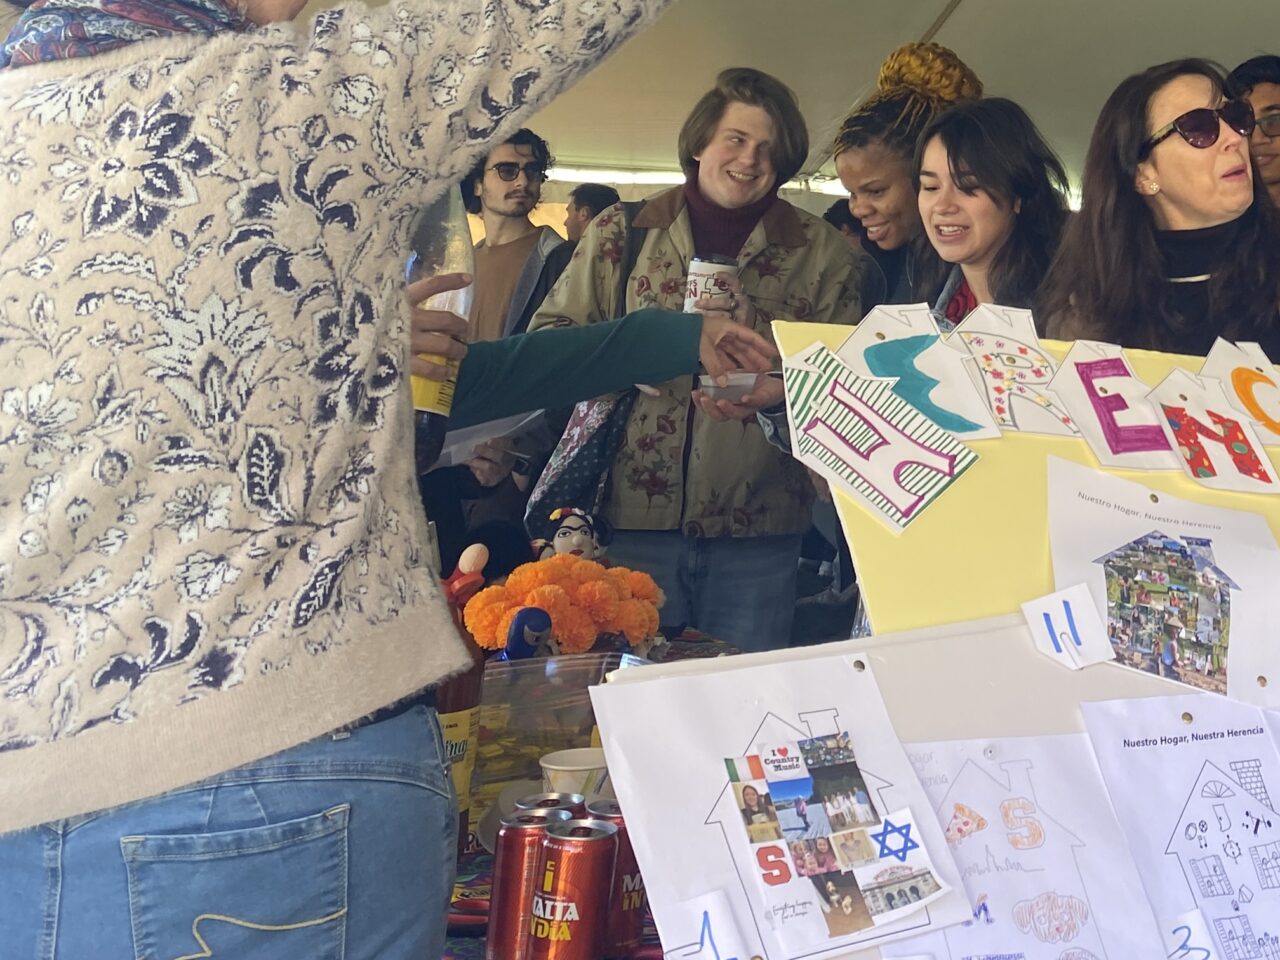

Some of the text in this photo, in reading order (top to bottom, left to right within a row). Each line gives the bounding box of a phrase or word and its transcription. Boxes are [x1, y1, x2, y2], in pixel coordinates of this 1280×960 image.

[1078, 491, 1111, 508] Nuestro
[1114, 504, 1142, 518] Hogar,
[1123, 726, 1264, 748] Nuestro Hogar, Nuestra Herencia
[764, 756, 800, 765] Country
[774, 764, 800, 772] Music
[1000, 797, 1045, 850] S
[756, 845, 792, 886] S
[533, 897, 580, 921] ALTA
